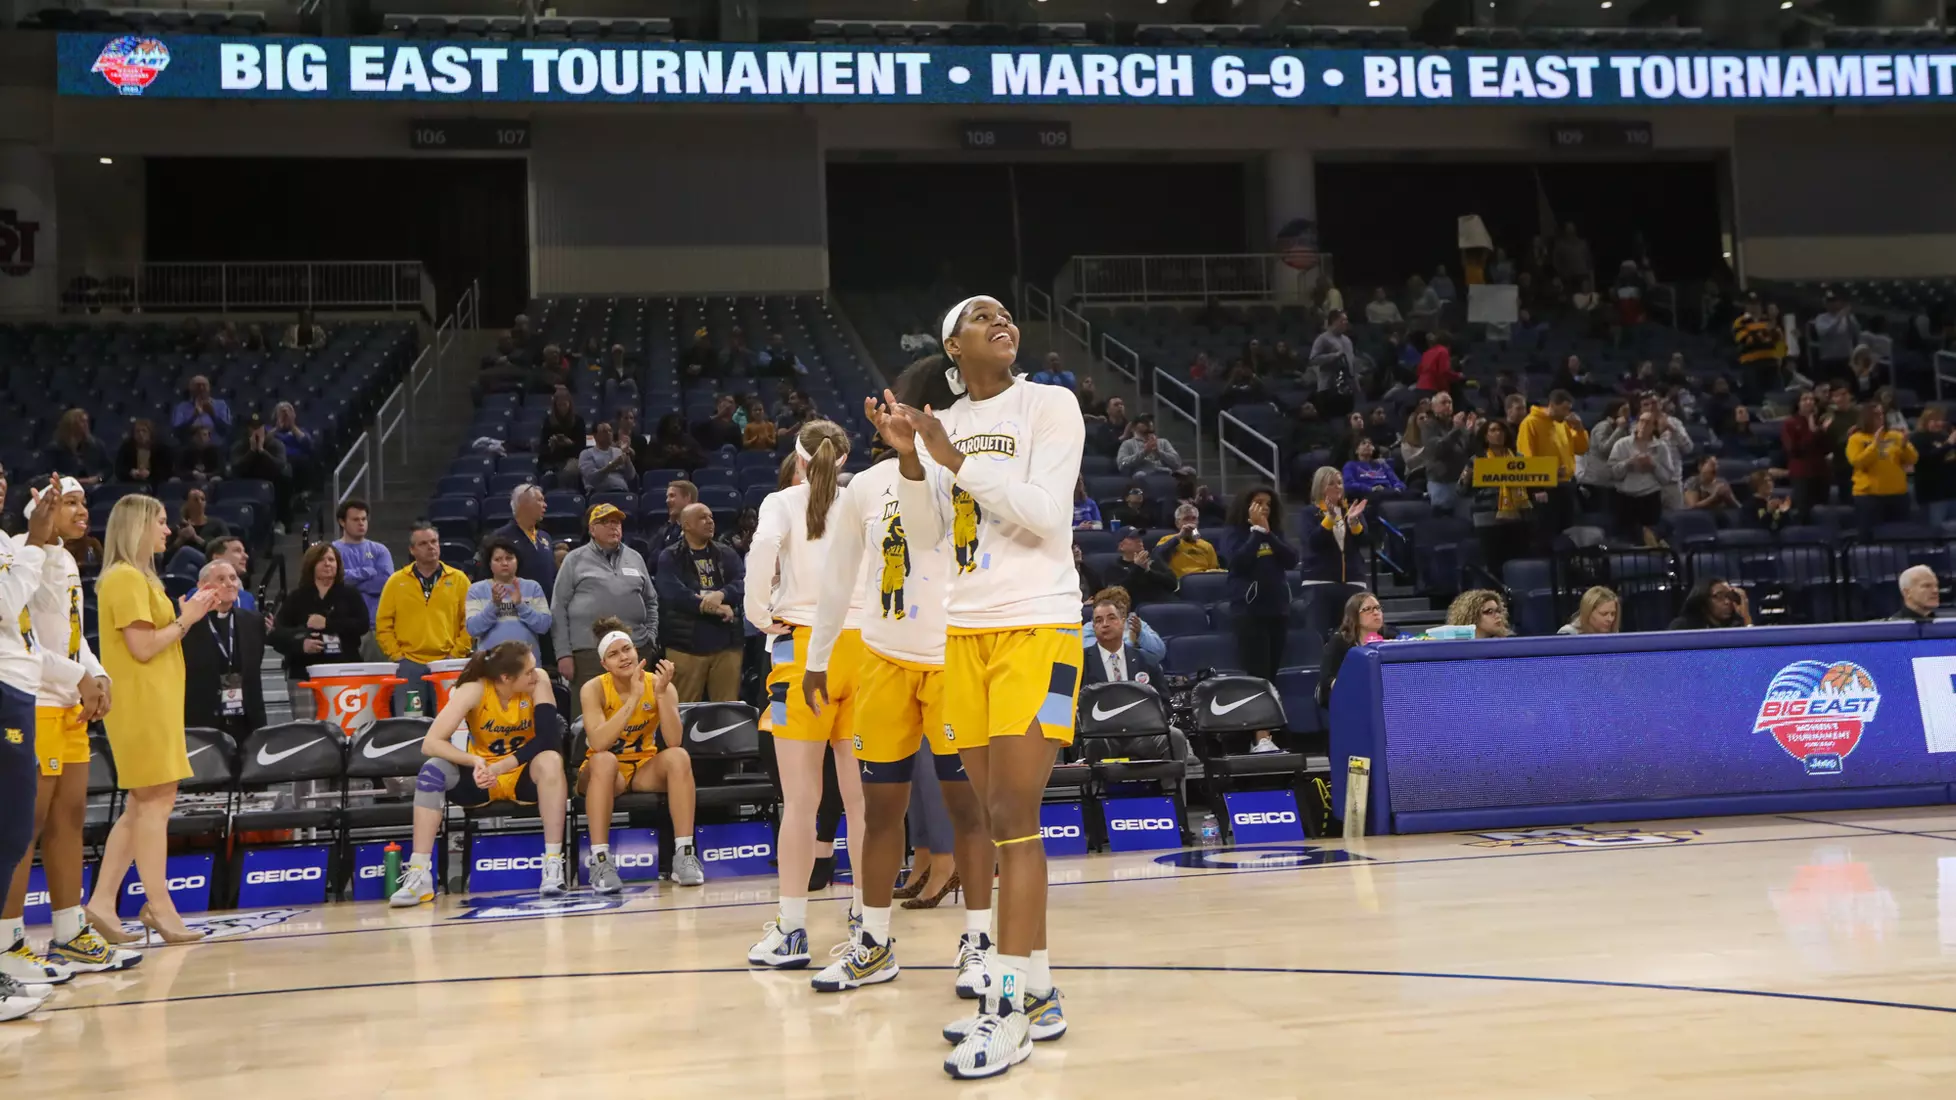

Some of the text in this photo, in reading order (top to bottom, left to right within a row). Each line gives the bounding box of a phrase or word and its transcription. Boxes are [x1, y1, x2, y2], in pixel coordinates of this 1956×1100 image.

[221, 44, 328, 91] BIG
[350, 46, 508, 93] EAST
[523, 49, 931, 95] TOURNAMENT
[992, 54, 1194, 96] MARCH
[1363, 56, 1453, 97] BIG
[1468, 56, 1600, 98] EAST
[1610, 55, 1956, 98] TOURNAMENT
[416, 129, 525, 144] 106 107
[966, 130, 1067, 146] 108 109
[1506, 460, 1526, 471] GO
[1482, 473, 1549, 482] MARQUETTE
[339, 689, 361, 712] G
[1762, 698, 1874, 717] BIG EAST
[1110, 818, 1174, 831] GEICO
[1234, 811, 1297, 825] GEICO
[703, 843, 771, 862] GEICO
[246, 866, 322, 884] GEICO
